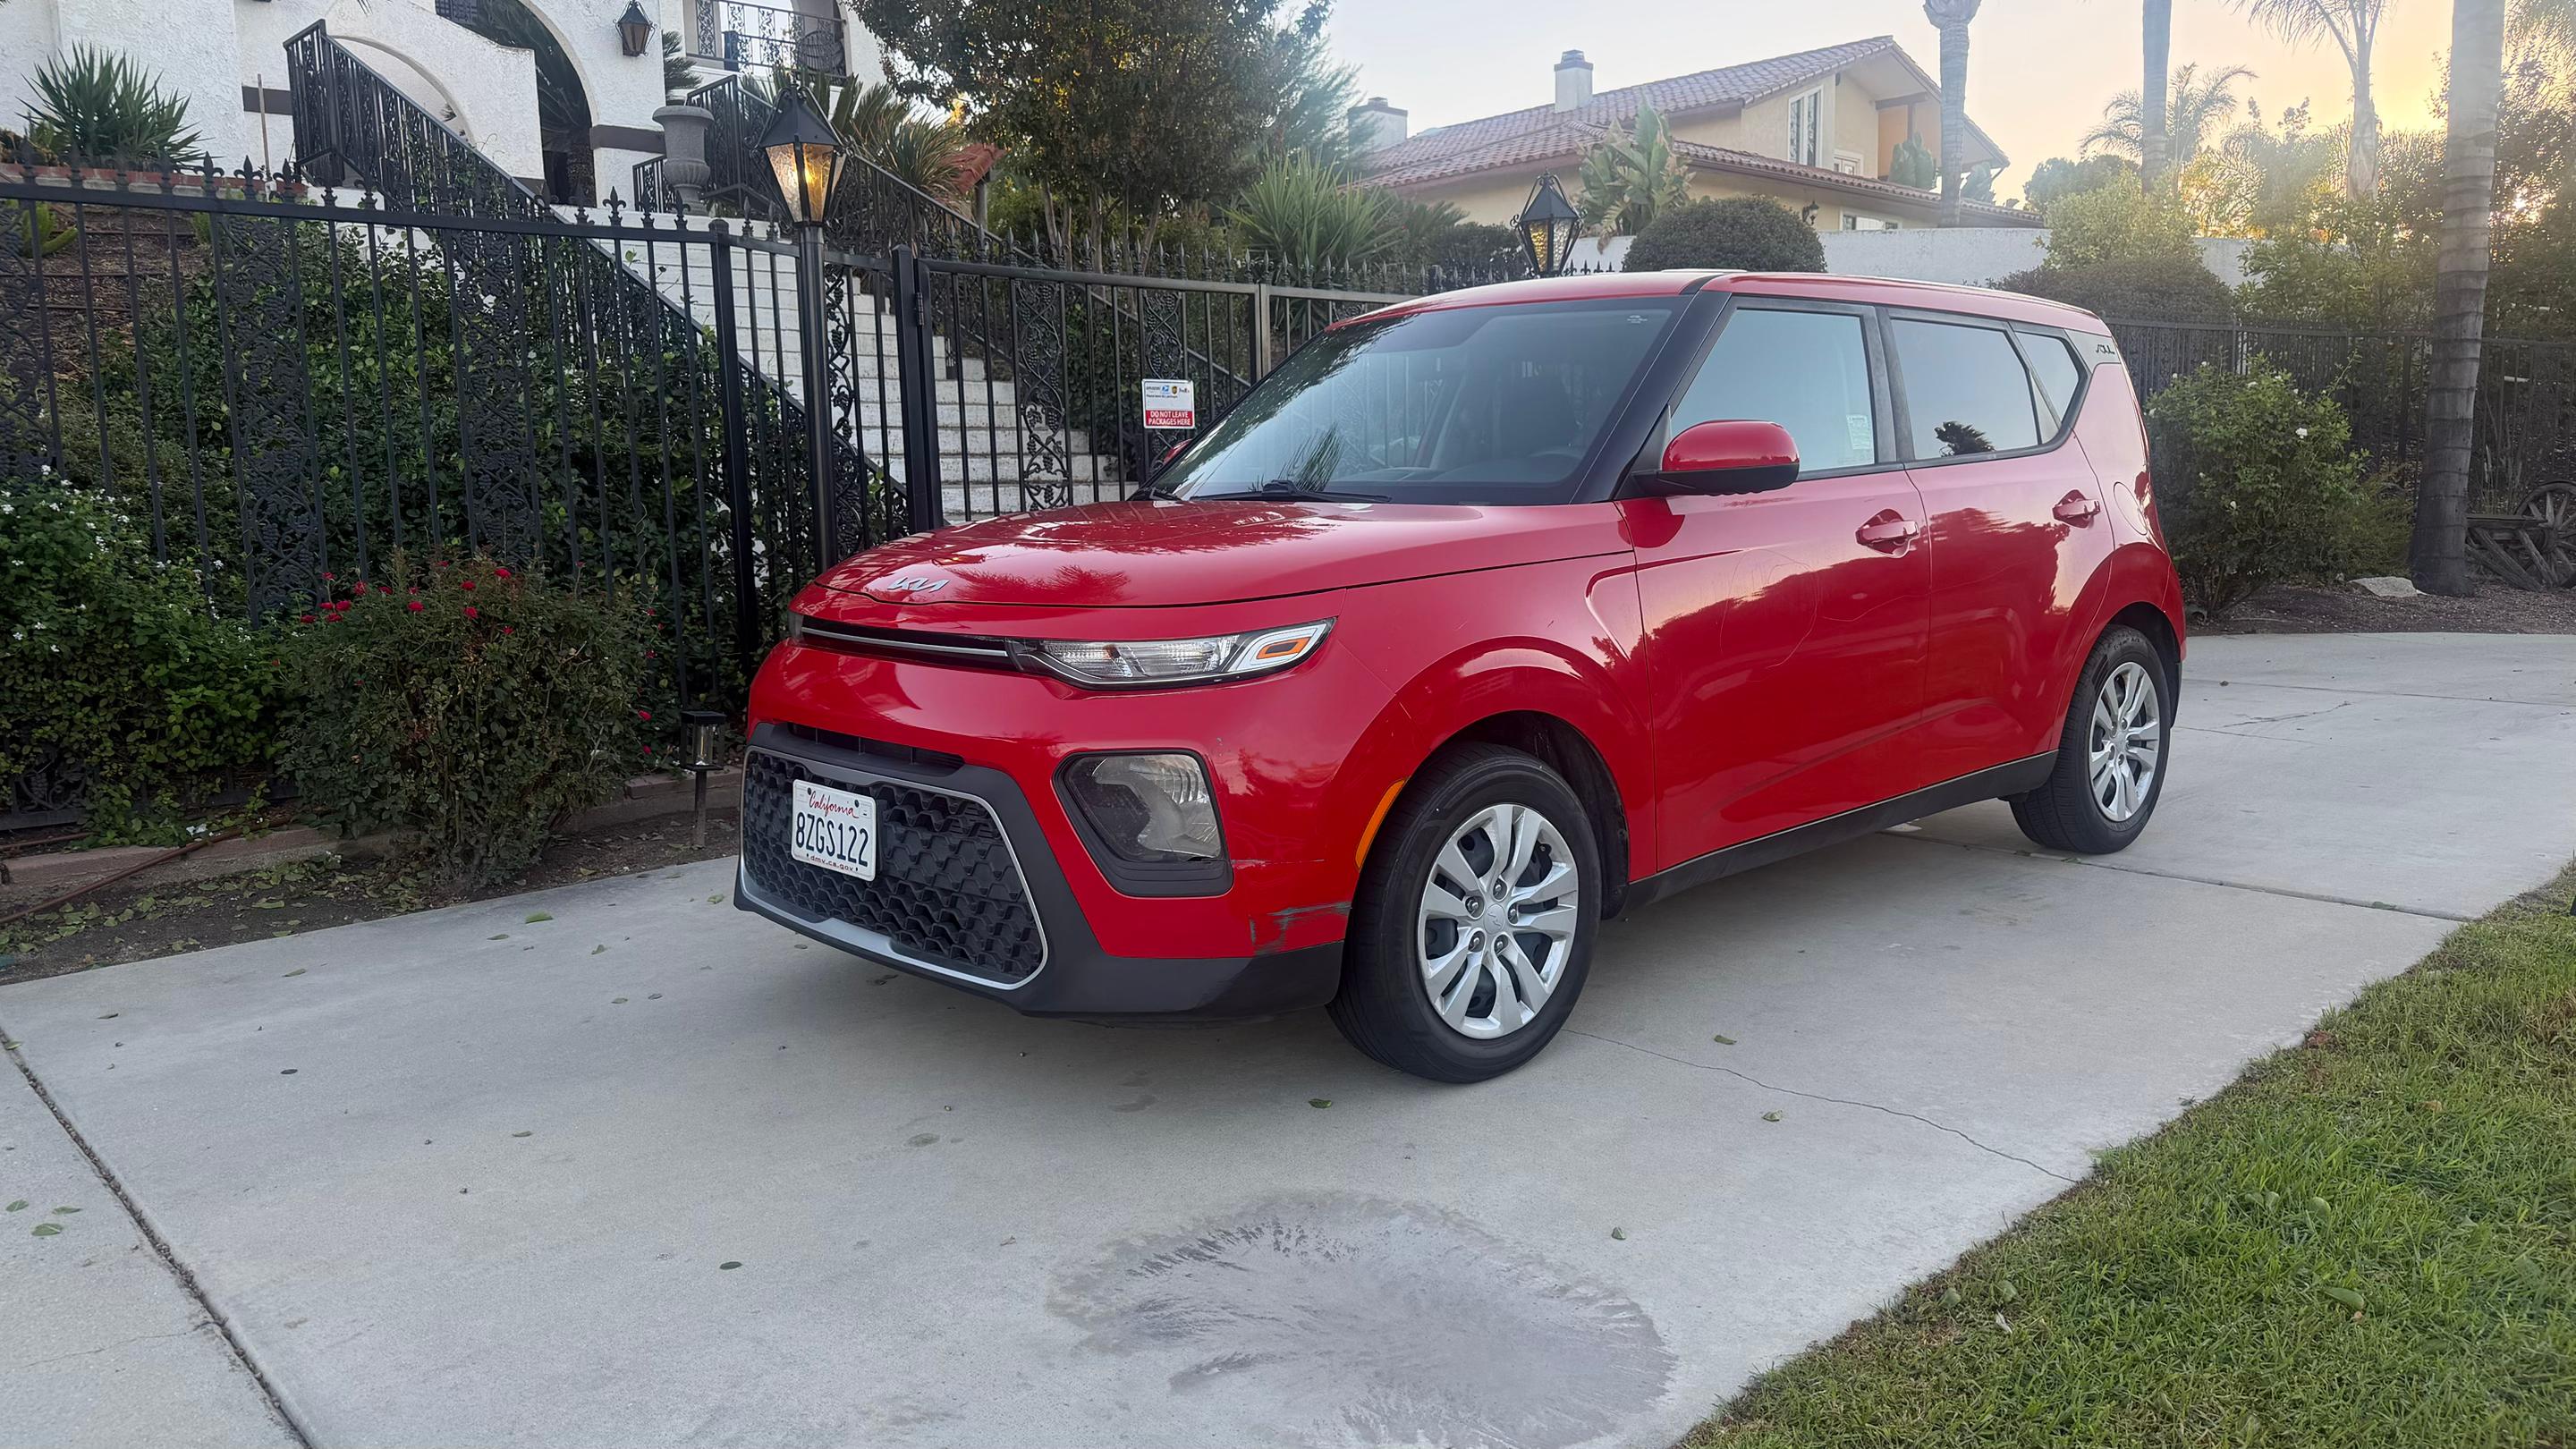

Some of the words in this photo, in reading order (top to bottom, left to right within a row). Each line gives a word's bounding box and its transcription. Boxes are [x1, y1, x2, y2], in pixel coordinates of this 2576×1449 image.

[1148, 418, 1177, 426] PACKAGES
[1177, 418, 1191, 426] HERE
[887, 577, 950, 593] KIA
[809, 790, 860, 818] California
[795, 811, 869, 868] 8ZGS122
[809, 855, 854, 872] dmv.ca.gov
